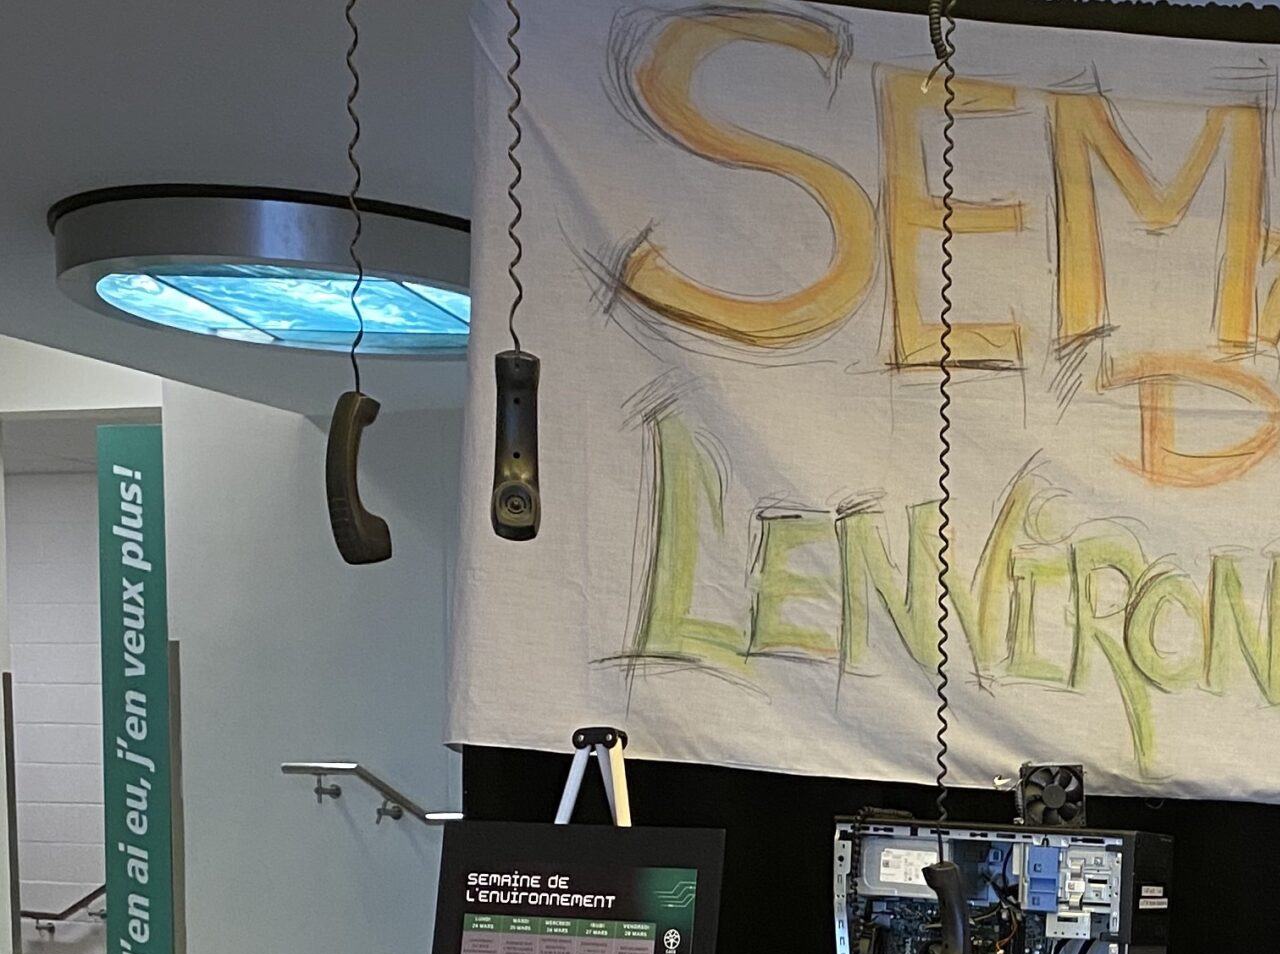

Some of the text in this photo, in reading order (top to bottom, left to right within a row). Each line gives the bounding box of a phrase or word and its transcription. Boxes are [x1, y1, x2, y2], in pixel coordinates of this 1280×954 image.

[112, 464, 152, 571] plus!
[122, 577, 147, 678] veux
[116, 699, 155, 773] j'en
[120, 771, 152, 833] eu,
[118, 843, 149, 885] ai
[467, 870, 541, 887] SEMAINE
[465, 887, 616, 909] L'ENVIRONNEMENT
